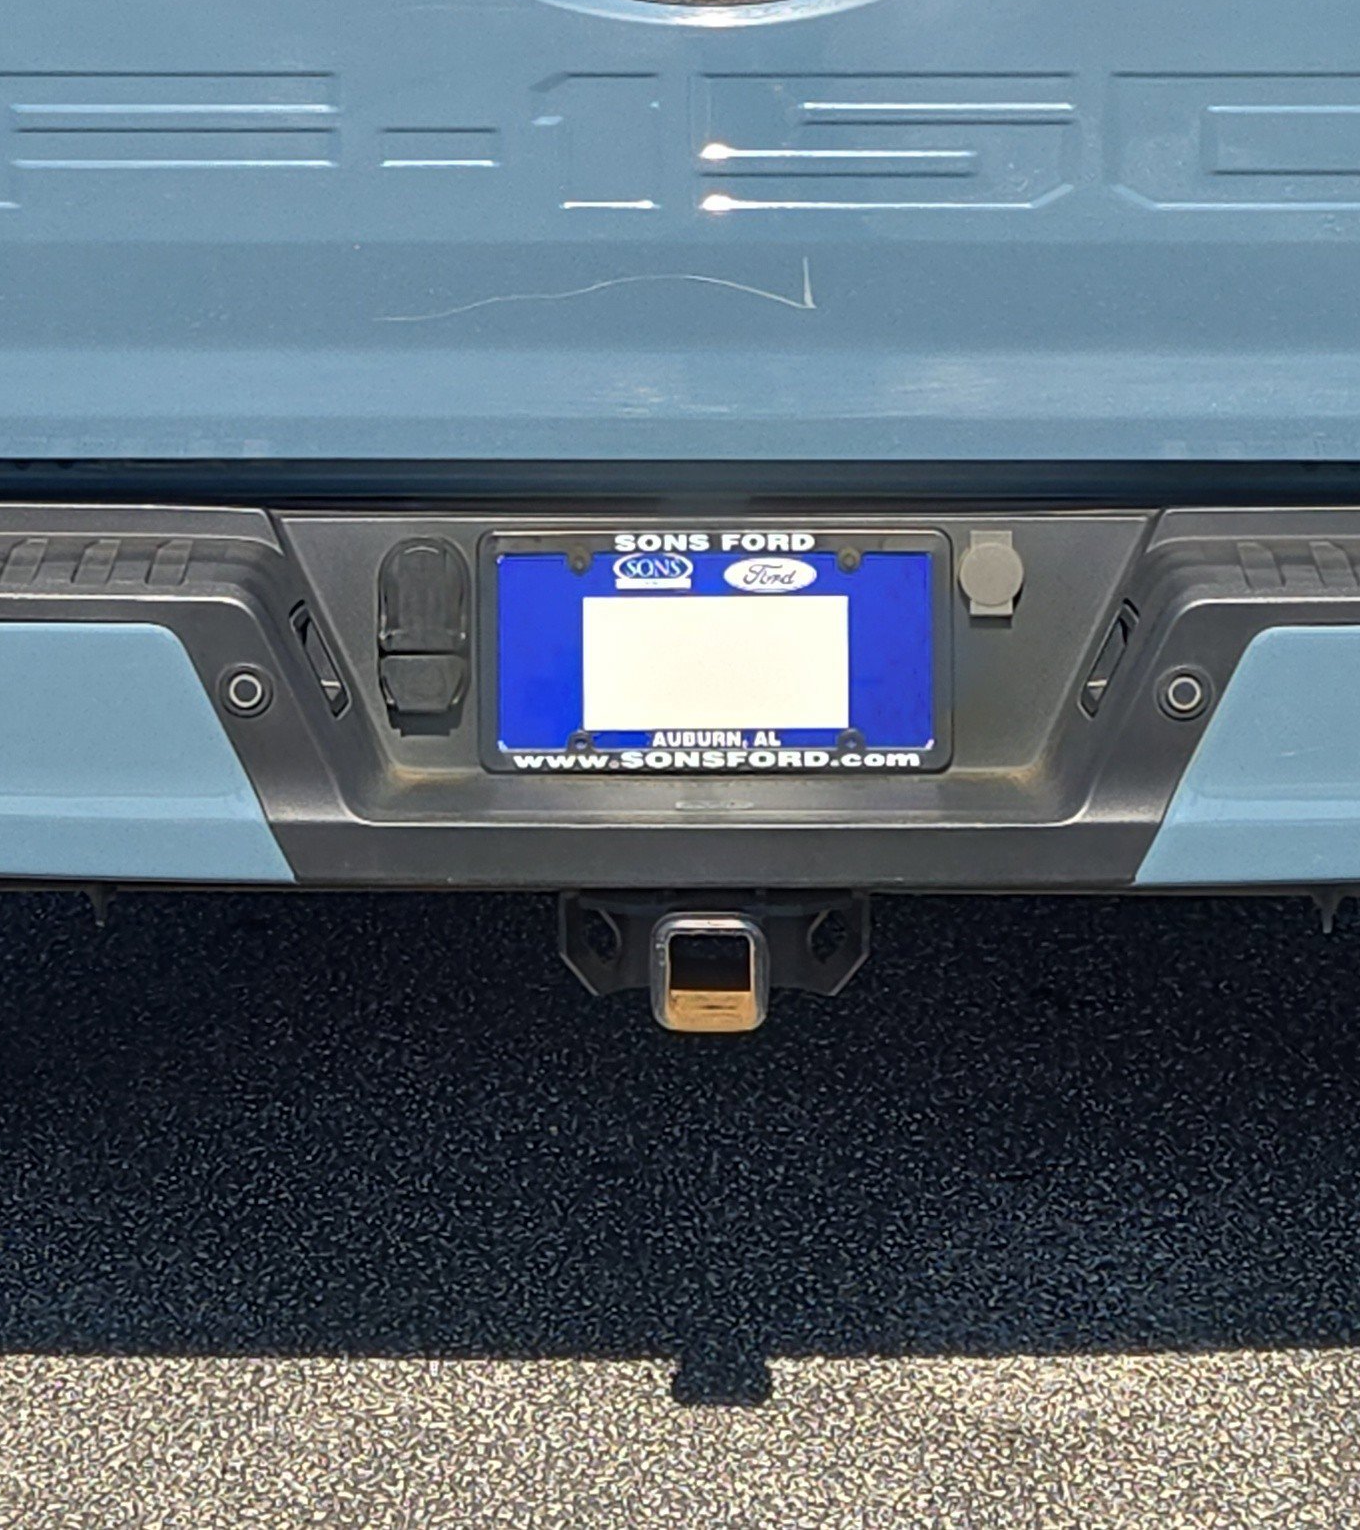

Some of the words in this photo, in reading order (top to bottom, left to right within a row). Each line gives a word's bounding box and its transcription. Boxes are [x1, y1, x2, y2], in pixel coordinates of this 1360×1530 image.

[614, 534, 710, 551] SONS
[721, 534, 815, 551] FORD
[625, 555, 683, 578] SONS
[742, 564, 797, 585] Ford
[652, 730, 748, 748] AUBURN,
[753, 731, 781, 747] AL
[513, 750, 920, 769] www.SONSFORD.com
